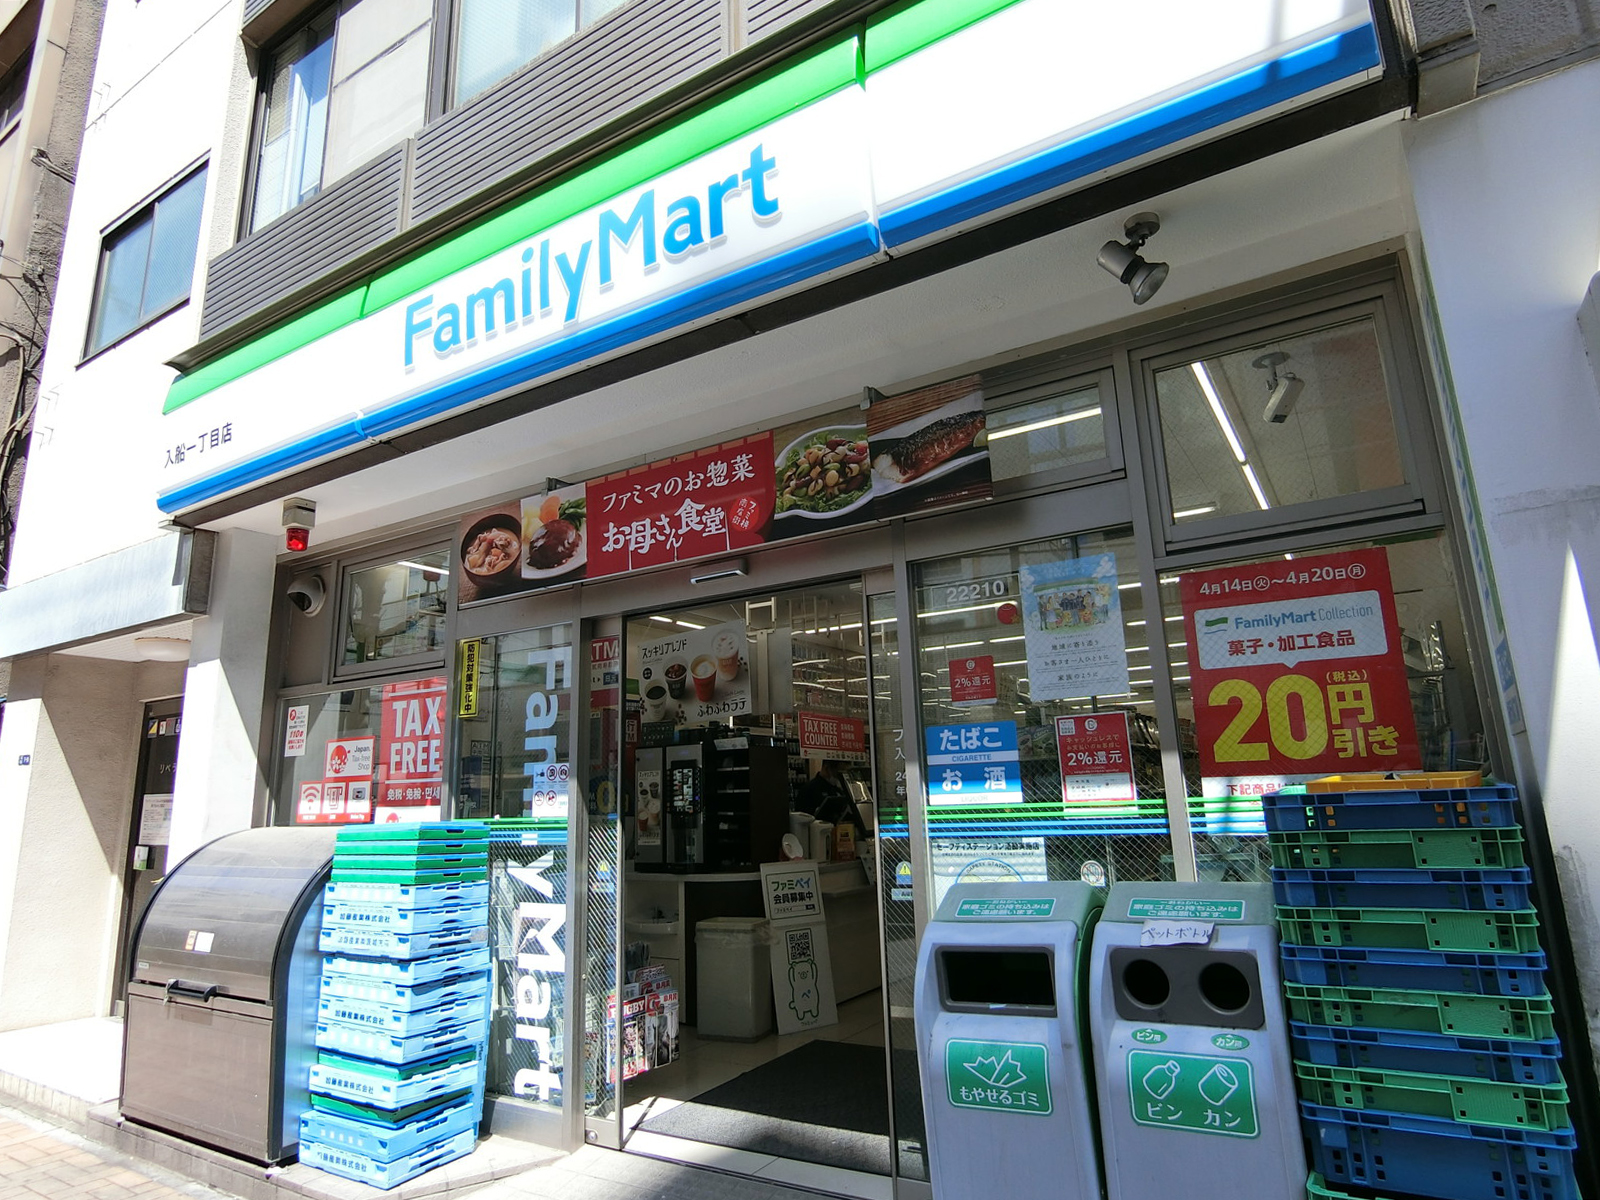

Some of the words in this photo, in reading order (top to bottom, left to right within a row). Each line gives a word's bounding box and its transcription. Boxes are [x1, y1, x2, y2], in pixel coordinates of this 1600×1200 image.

[404, 143, 780, 367] FamilyMart
[164, 422, 232, 468] 入船一丁目店
[603, 453, 755, 512] ファミマのお惣菜
[602, 498, 726, 553] お母さん食堂
[947, 580, 1005, 602] 22210
[1235, 610, 1316, 630] FamilyMart
[1318, 605, 1374, 622] Collection
[591, 640, 619, 660] TM
[1227, 629, 1356, 656] 菓子・加工食品
[463, 643, 476, 713] 防犯対策強化中
[954, 675, 991, 688] 2%還元
[393, 697, 441, 738] TAX
[697, 698, 747, 717] ふわふわラテ
[1208, 674, 1329, 763] 20
[1327, 682, 1375, 725] 円
[803, 719, 819, 733] TAX
[820, 721, 838, 735] FREE
[804, 732, 839, 746] COUNTER
[939, 726, 1003, 751] たばこ
[1332, 725, 1400, 759] 引き
[352, 755, 371, 763] Tax-free
[390, 739, 441, 774] FREE
[951, 753, 992, 762] CIGARETTE
[1067, 750, 1123, 766] 2%還元
[966, 862, 986, 873] SAFETY
[987, 861, 1012, 873] STATION
[772, 877, 811, 891] ファミペイ
[773, 891, 814, 904] 会員募集中
[1142, 926, 1212, 939] ペットボトル
[959, 1086, 1040, 1107] もやせるゴミ
[1147, 1101, 1183, 1122] ビン
[1204, 1109, 1241, 1127] カン
